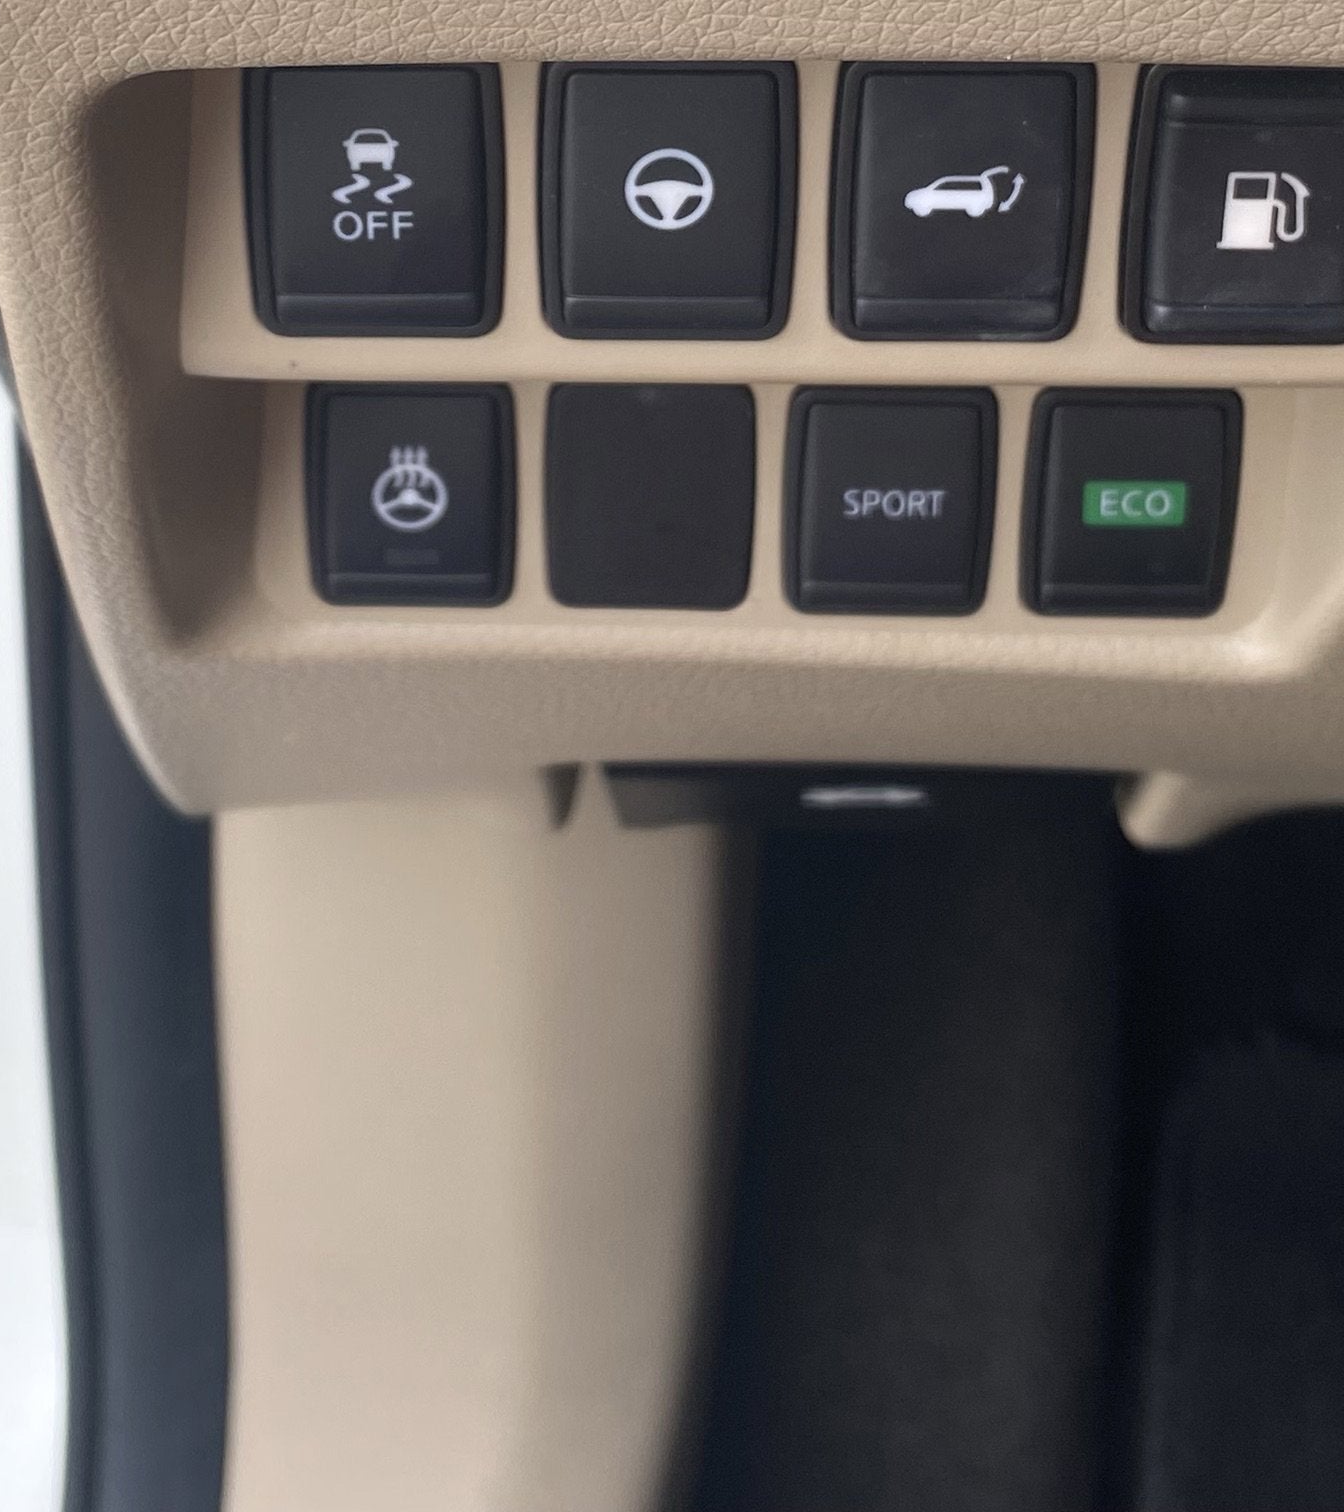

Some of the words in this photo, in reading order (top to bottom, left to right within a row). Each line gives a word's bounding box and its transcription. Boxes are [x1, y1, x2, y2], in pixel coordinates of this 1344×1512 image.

[332, 210, 414, 242] OFF
[842, 488, 945, 519] SPORT
[1098, 488, 1171, 519] ECO
